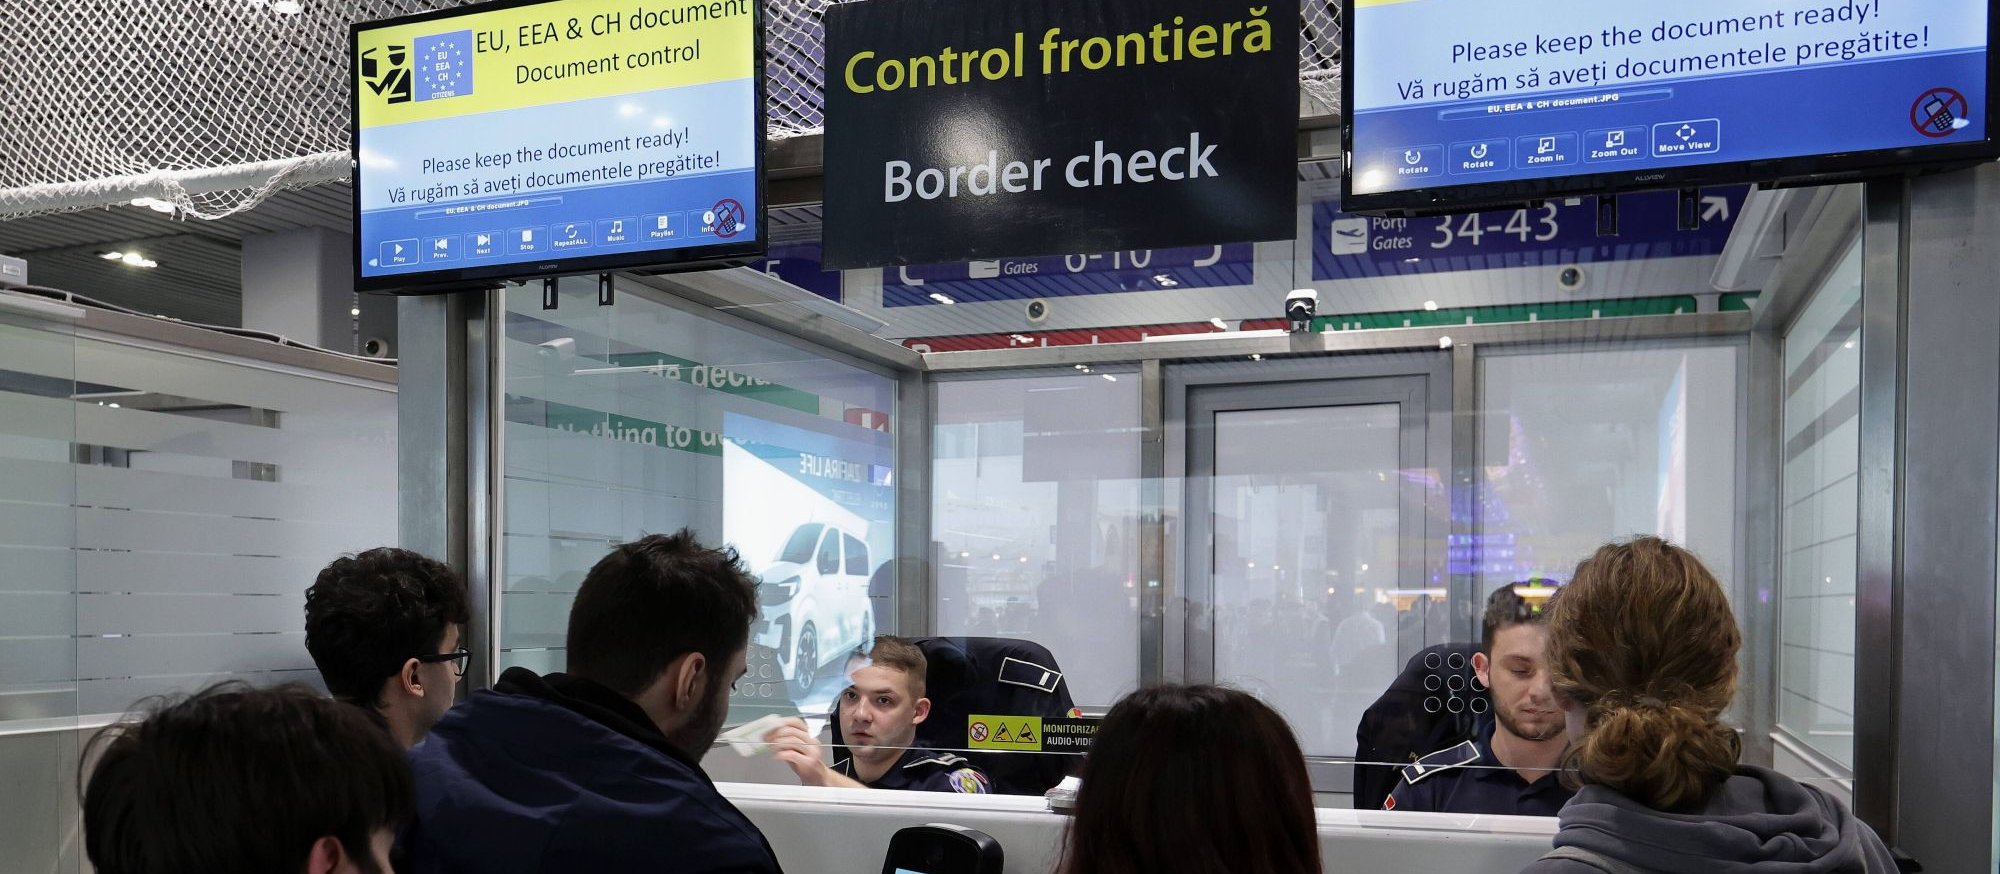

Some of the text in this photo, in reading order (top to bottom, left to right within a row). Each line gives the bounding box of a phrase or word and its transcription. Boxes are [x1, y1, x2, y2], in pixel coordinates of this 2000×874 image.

[477, 0, 748, 54] EU, EEA & CH document
[1452, 0, 1880, 63] Please keep the document ready!
[437, 51, 448, 60] EU
[844, 5, 1272, 94] Control frontieră
[435, 62, 450, 71] EEA
[516, 39, 700, 84] Document control
[1397, 25, 1929, 100] Vă rugăm să aveți documentele pregătite!
[437, 72, 449, 81] CH
[1487, 93, 1619, 114] EU, EEA & CH document.JPG
[423, 127, 689, 174] Please keep the document ready!
[1591, 147, 1638, 158] Zoom Out
[1659, 140, 1711, 152] Move View
[1463, 160, 1494, 169] Rotate
[1527, 153, 1564, 164] Zoom In
[884, 132, 1219, 203] Border check
[1398, 166, 1429, 175] Rotate
[388, 150, 720, 204] Vă rugăm să aveți documentele pregătite!
[1373, 202, 1559, 250] Gates 34-43
[607, 234, 625, 242] Music
[650, 230, 674, 238] Playlist
[554, 238, 588, 248] RepeatALL
[1004, 261, 1039, 275] Gates
[665, 424, 692, 448] to
